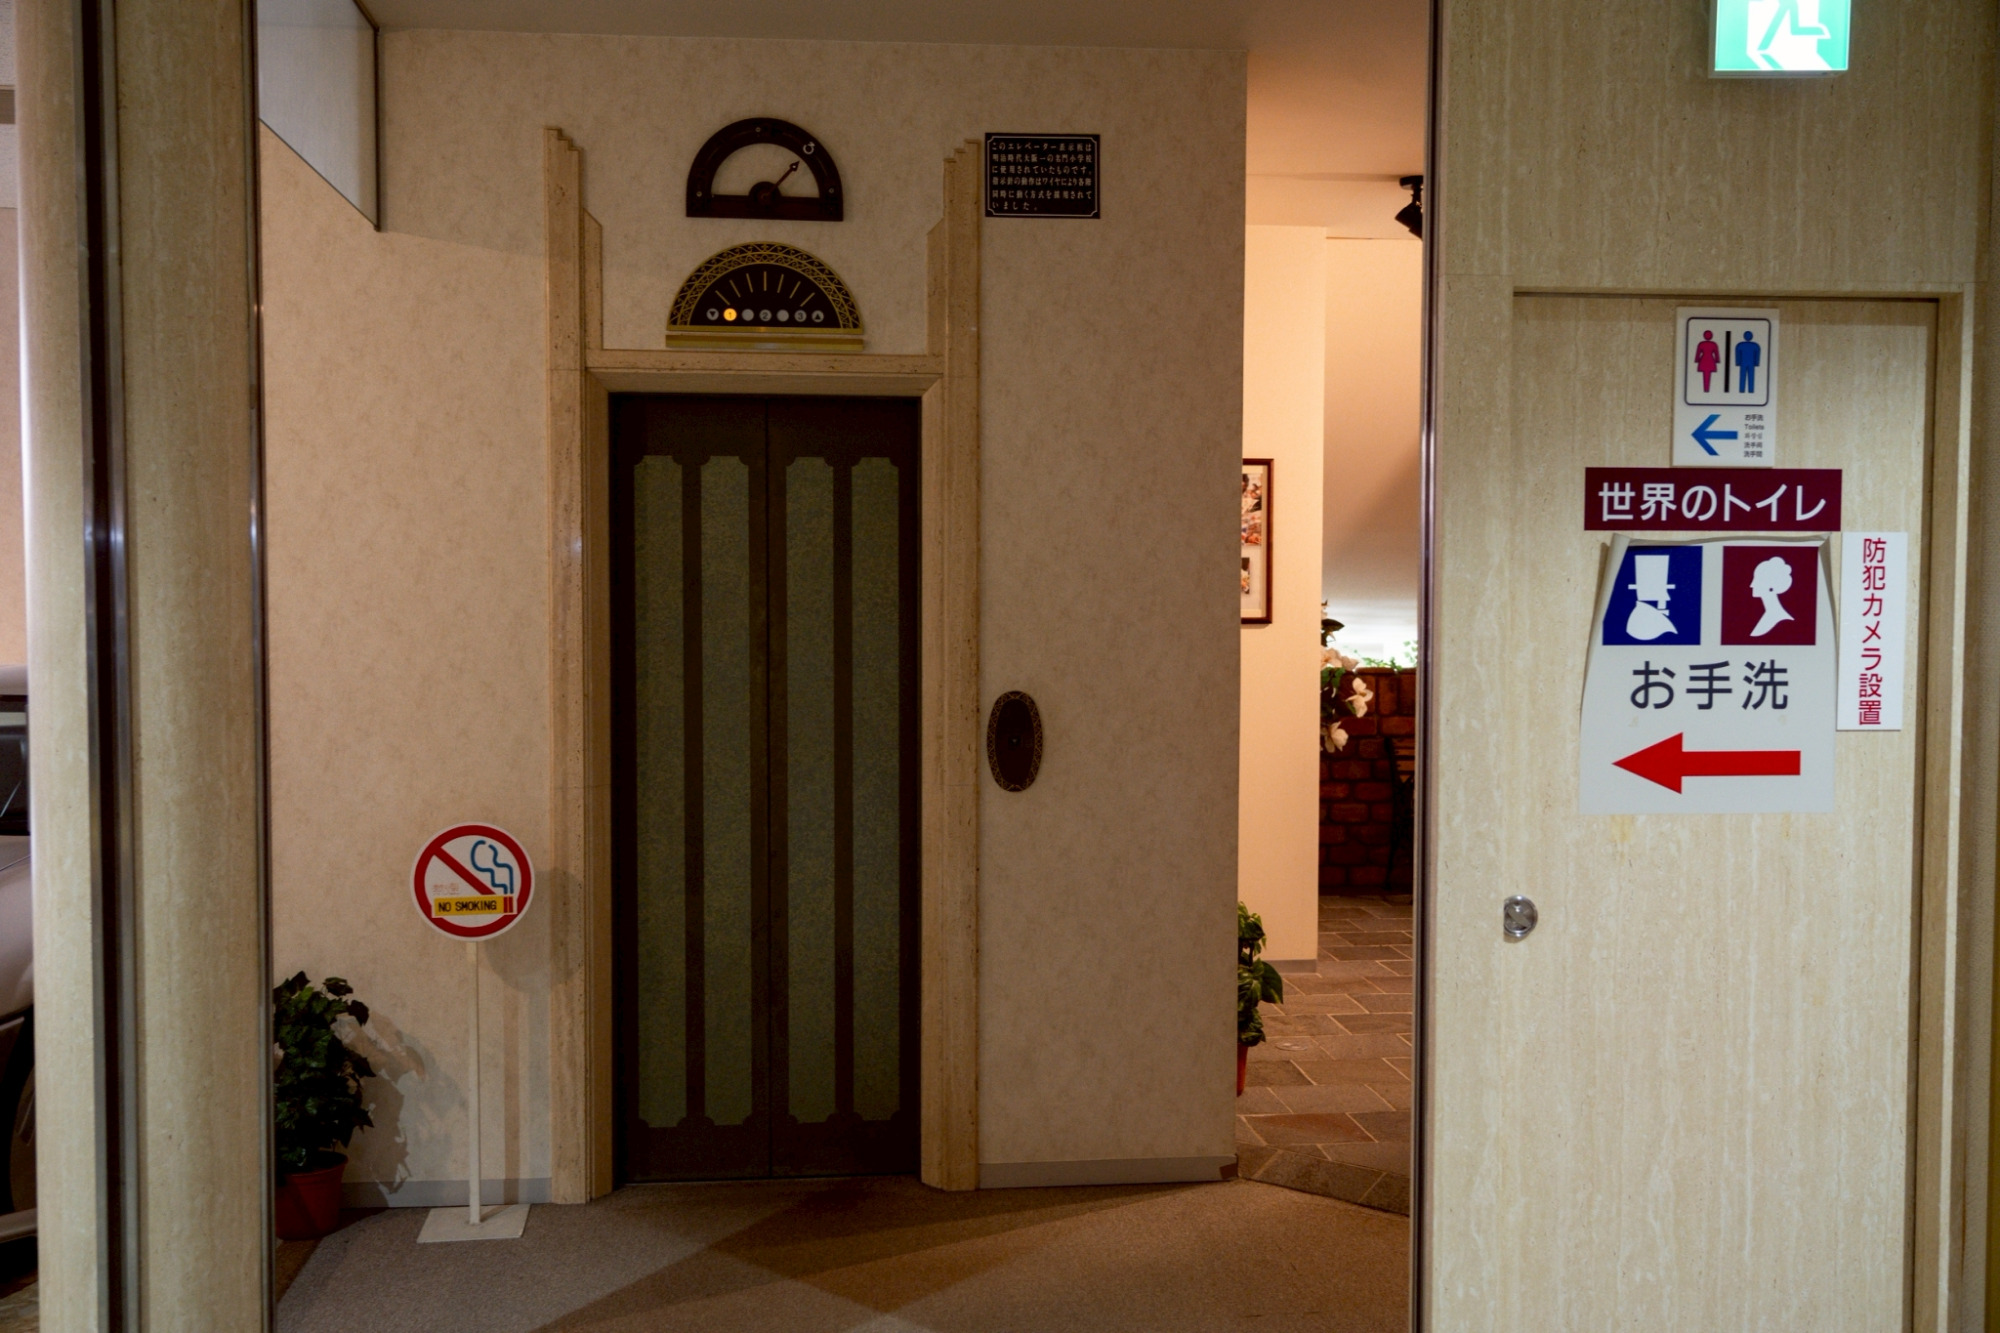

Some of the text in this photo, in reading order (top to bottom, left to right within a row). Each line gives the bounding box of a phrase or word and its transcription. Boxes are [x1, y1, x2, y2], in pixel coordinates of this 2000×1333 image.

[1597, 481, 1827, 523] 世界のトイレ
[1858, 537, 1887, 726] 防犯カメラ設置
[1629, 658, 1789, 711] お手洗
[438, 900, 497, 912] NO SMOKING
